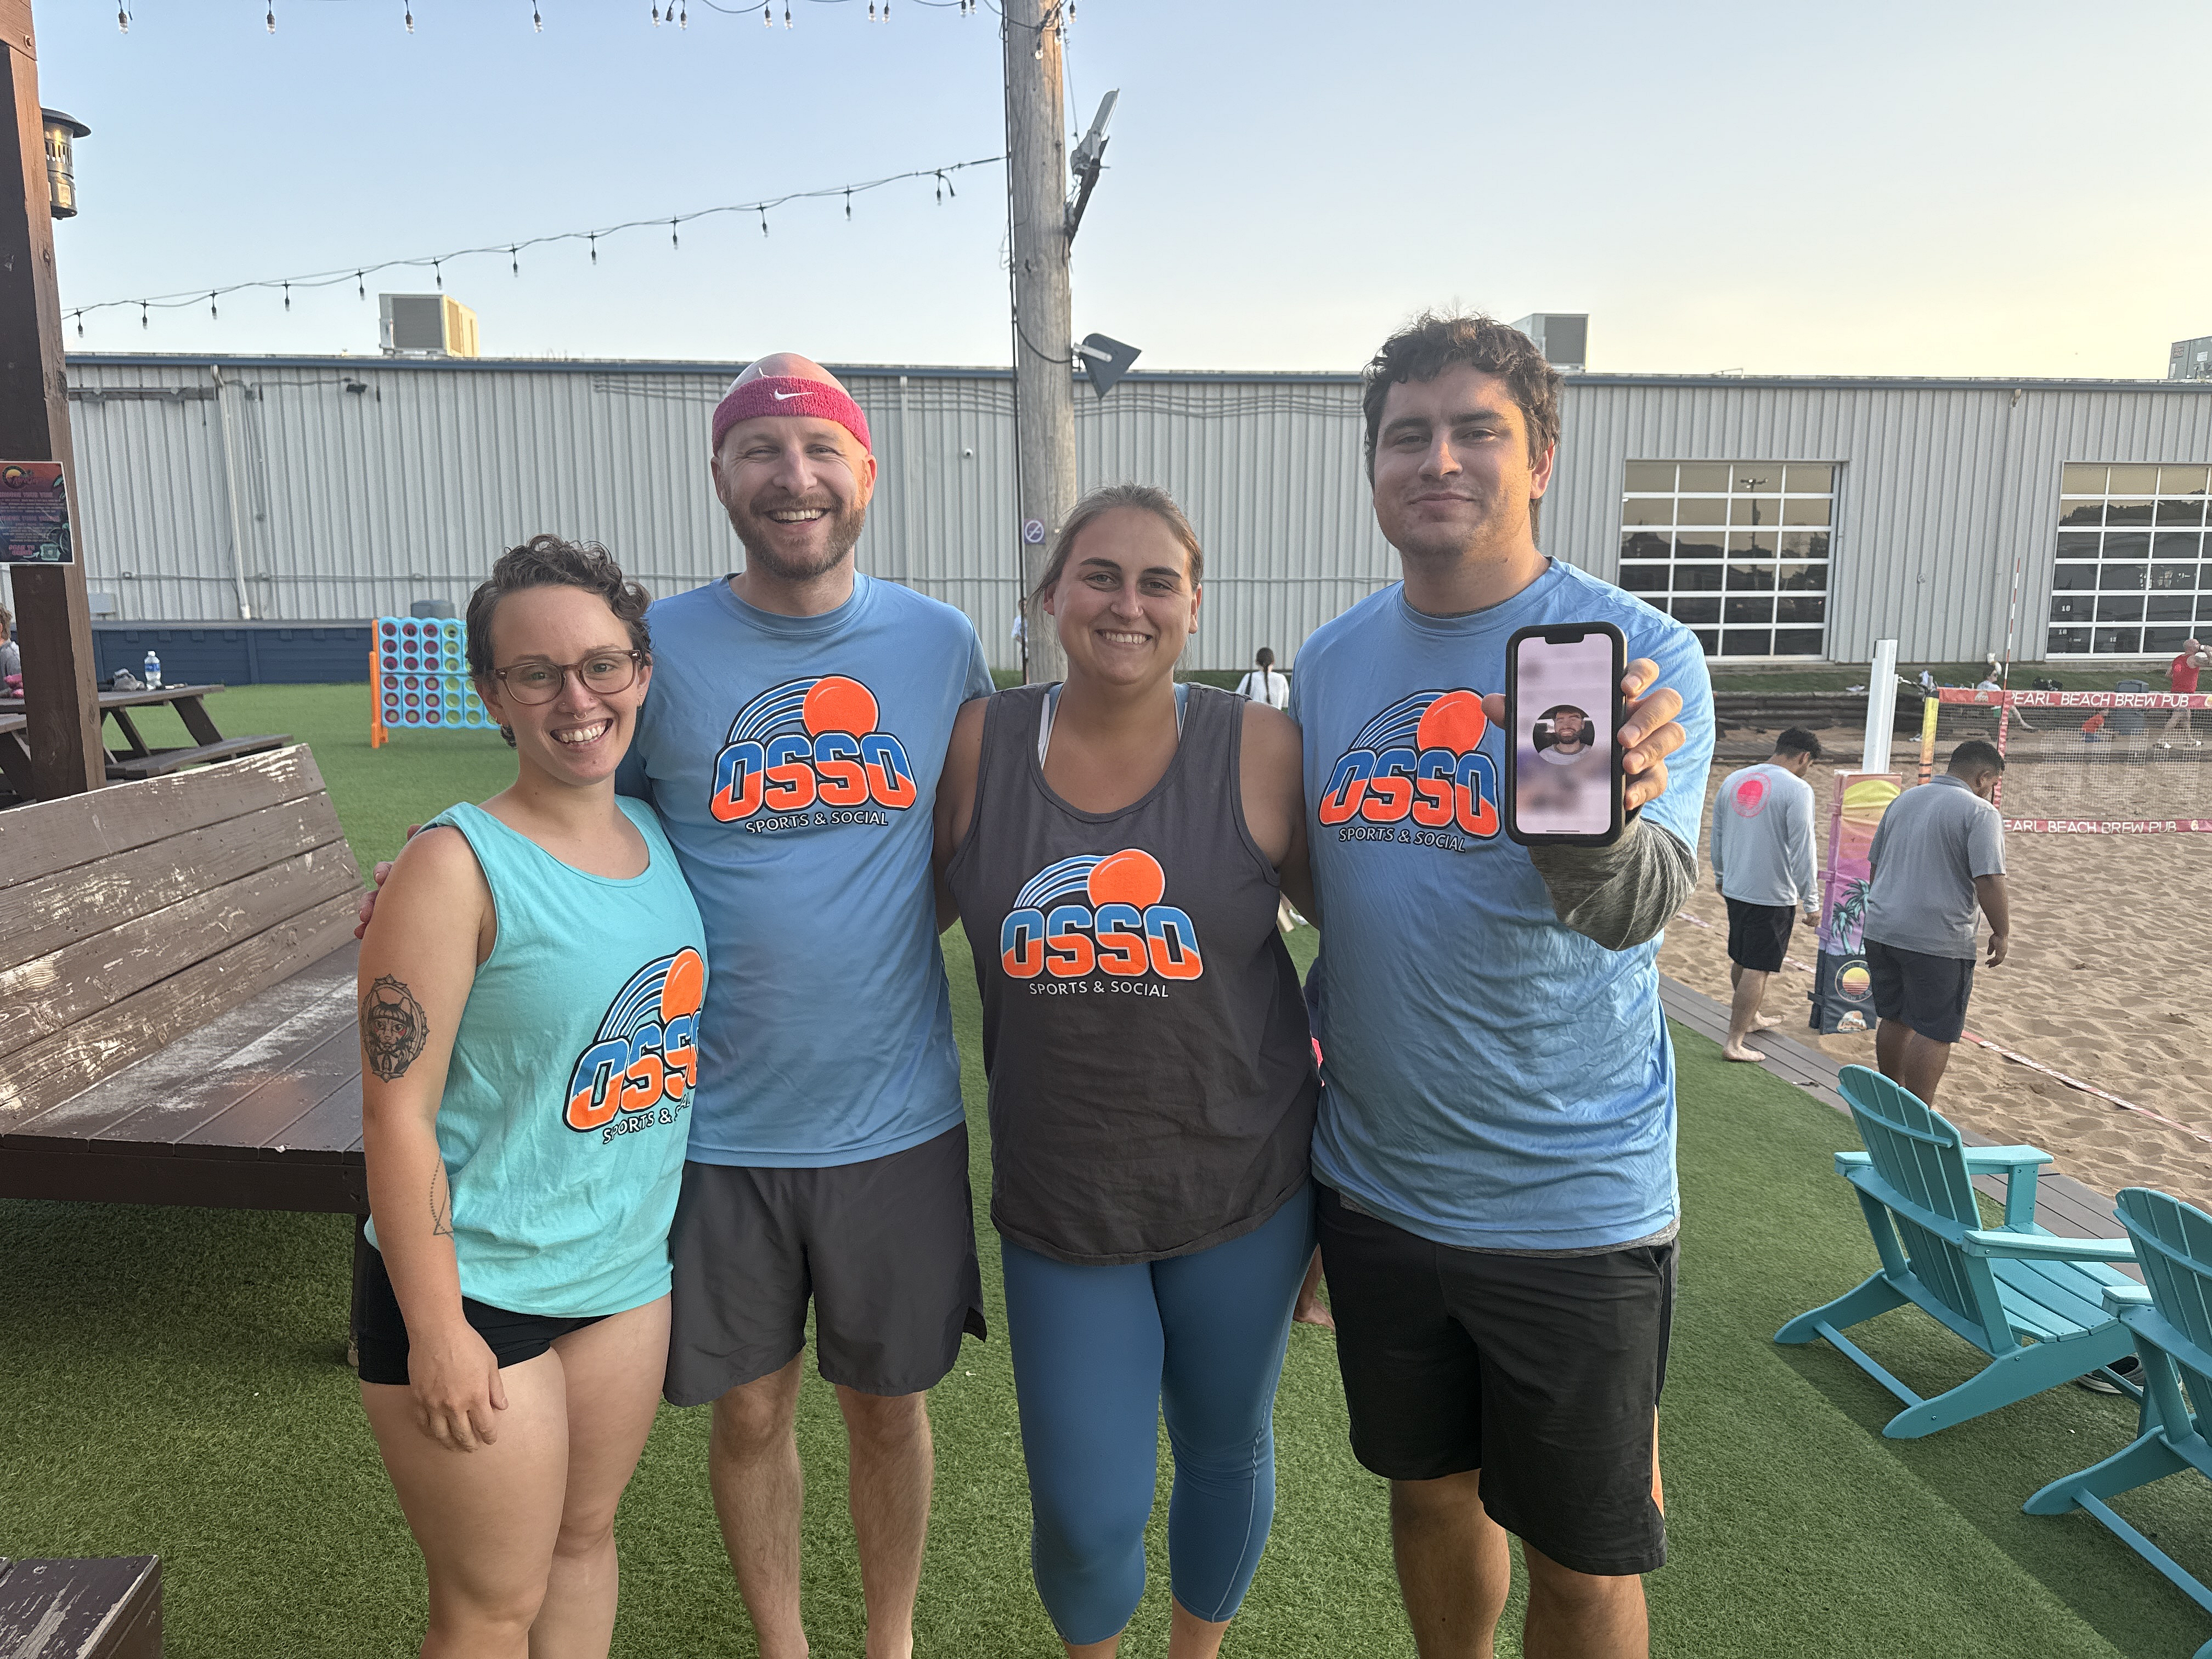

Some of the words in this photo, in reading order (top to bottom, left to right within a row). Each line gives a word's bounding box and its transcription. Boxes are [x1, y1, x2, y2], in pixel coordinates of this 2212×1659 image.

[2061, 693, 2111, 706] BEACH
[2115, 694, 2157, 707] BREW
[2161, 695, 2189, 707] PUB
[709, 732, 917, 823] OSSO
[1319, 746, 1500, 839] OSSO
[746, 814, 809, 833] SPORTS
[814, 812, 827, 825] &
[831, 810, 889, 826] SOCIAL
[2003, 819, 2042, 832] EARL
[2048, 820, 2096, 833] BEACH
[2101, 821, 2145, 834] BREW
[2148, 821, 2177, 833] PUB
[1339, 826, 1395, 842] SPORTS
[1398, 829, 1411, 843] &
[1414, 831, 1465, 853] SOCIAL
[1000, 904, 1204, 980] OSSO
[1029, 981, 1087, 995] SPORTS
[1093, 980, 1105, 993] &
[1110, 980, 1169, 997] SOCIAL
[602, 1111, 654, 1144] SPORTS
[658, 1108, 673, 1124] &
